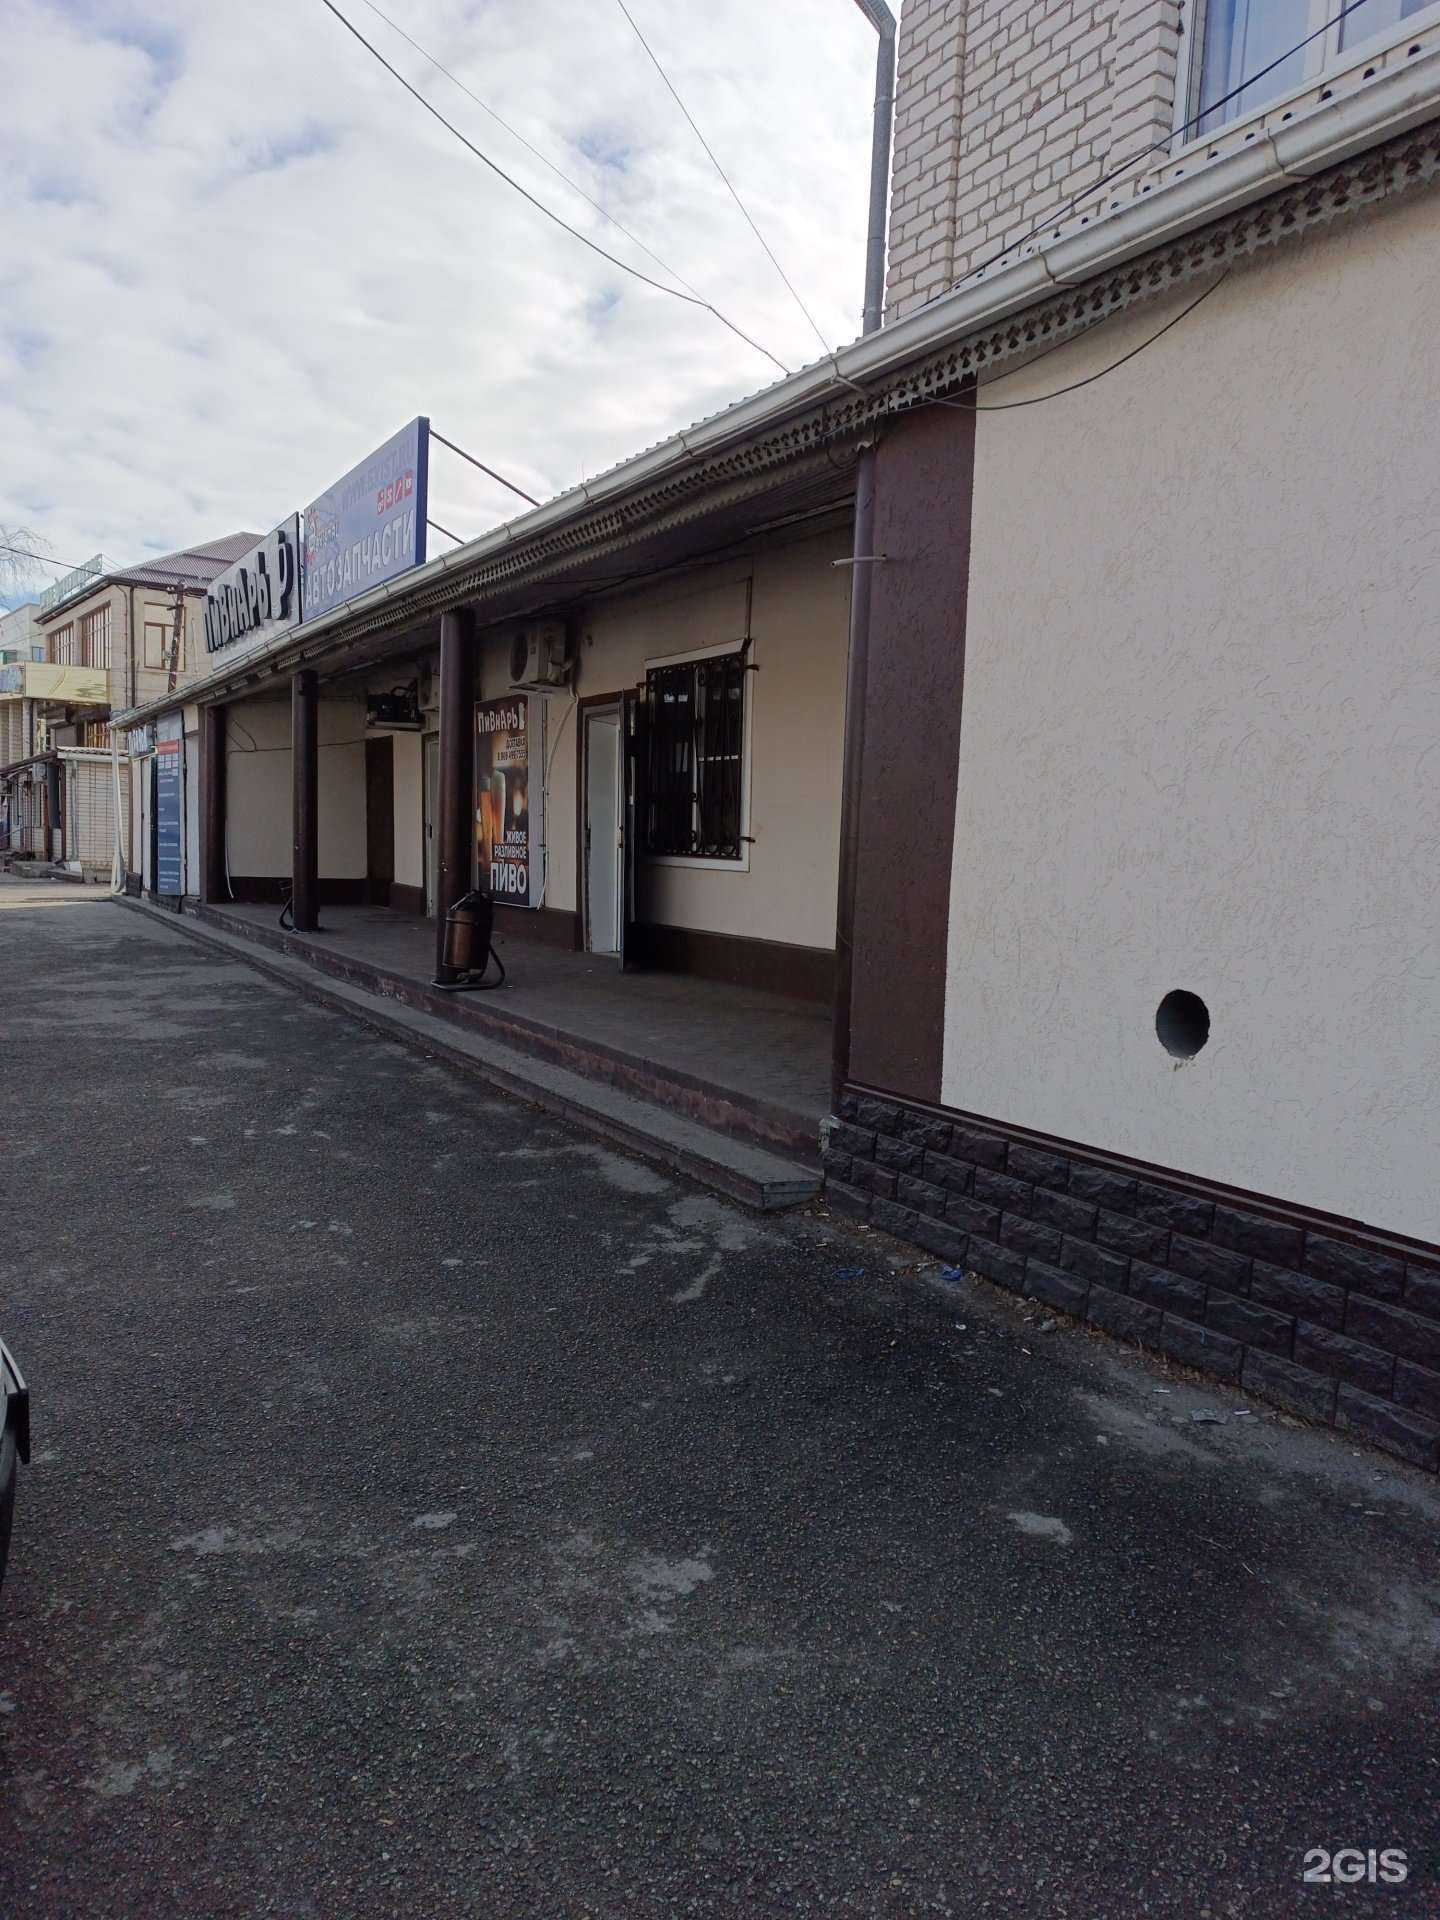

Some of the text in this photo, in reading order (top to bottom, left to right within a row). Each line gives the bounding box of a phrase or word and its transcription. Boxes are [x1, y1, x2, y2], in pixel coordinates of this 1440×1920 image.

[305, 510, 415, 607] АВТОЗАПЧАСТИ
[506, 831, 527, 844] ЖИВОЕ
[494, 845, 527, 859] РАЗЛИВНОЕ
[490, 862, 527, 895] ПИВО
